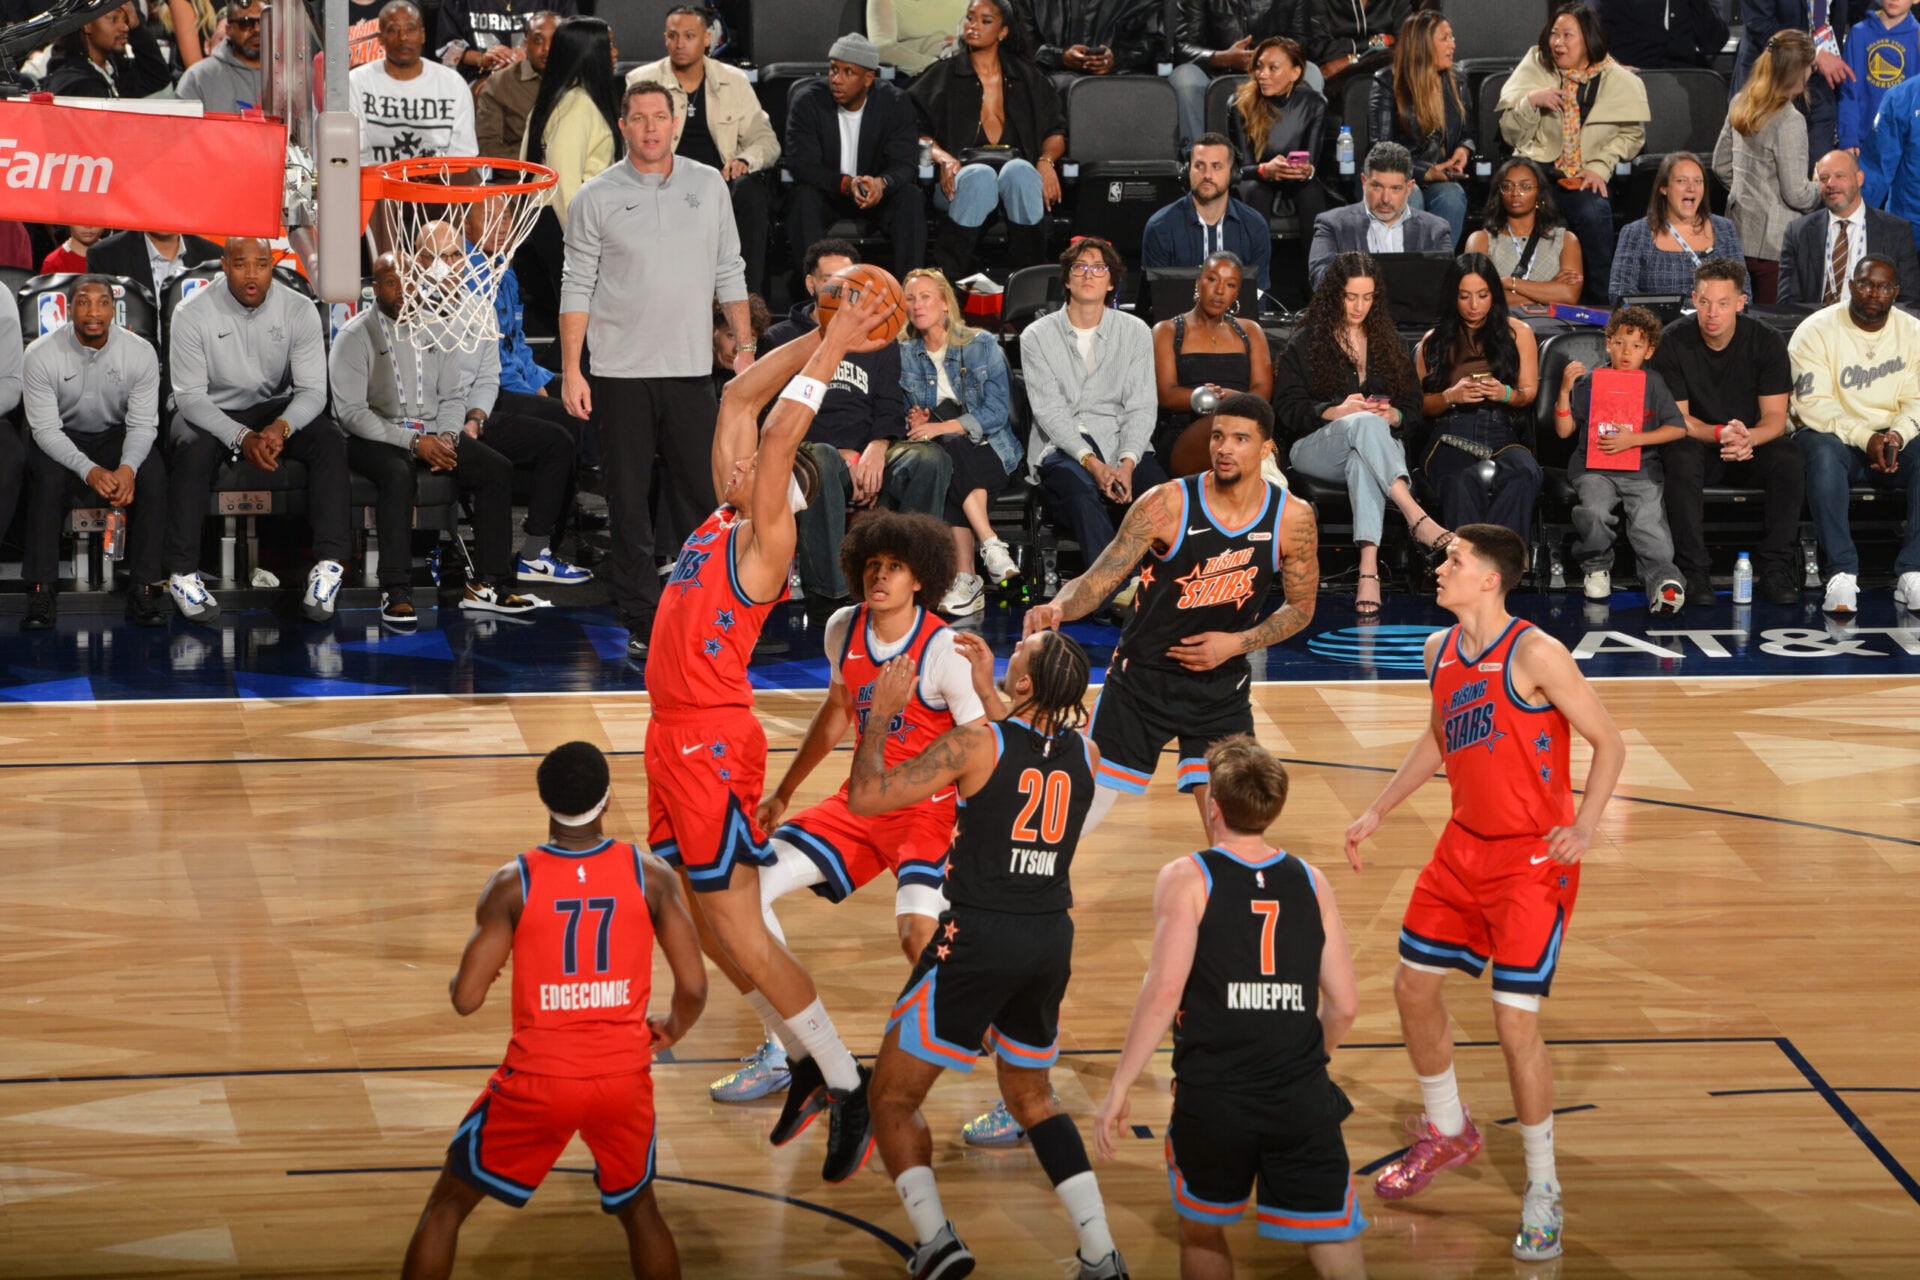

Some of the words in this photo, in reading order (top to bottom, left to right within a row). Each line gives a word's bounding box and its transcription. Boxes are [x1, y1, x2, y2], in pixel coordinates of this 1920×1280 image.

[0, 138, 114, 194] Farm
[1840, 355, 1906, 391] Clippers
[1202, 547, 1255, 575] RISING
[1177, 566, 1259, 610] STARS
[1571, 626, 1920, 660] AT&T
[1450, 679, 1489, 711] RISING
[1445, 701, 1495, 755] STARS
[1011, 767, 1071, 844] 20
[1009, 848, 1058, 877] TYSON
[554, 896, 617, 976] 77
[1251, 899, 1280, 976] 7
[539, 978, 632, 1011] EDGECOMBE
[1227, 982, 1306, 1012] KNUEPPEL
